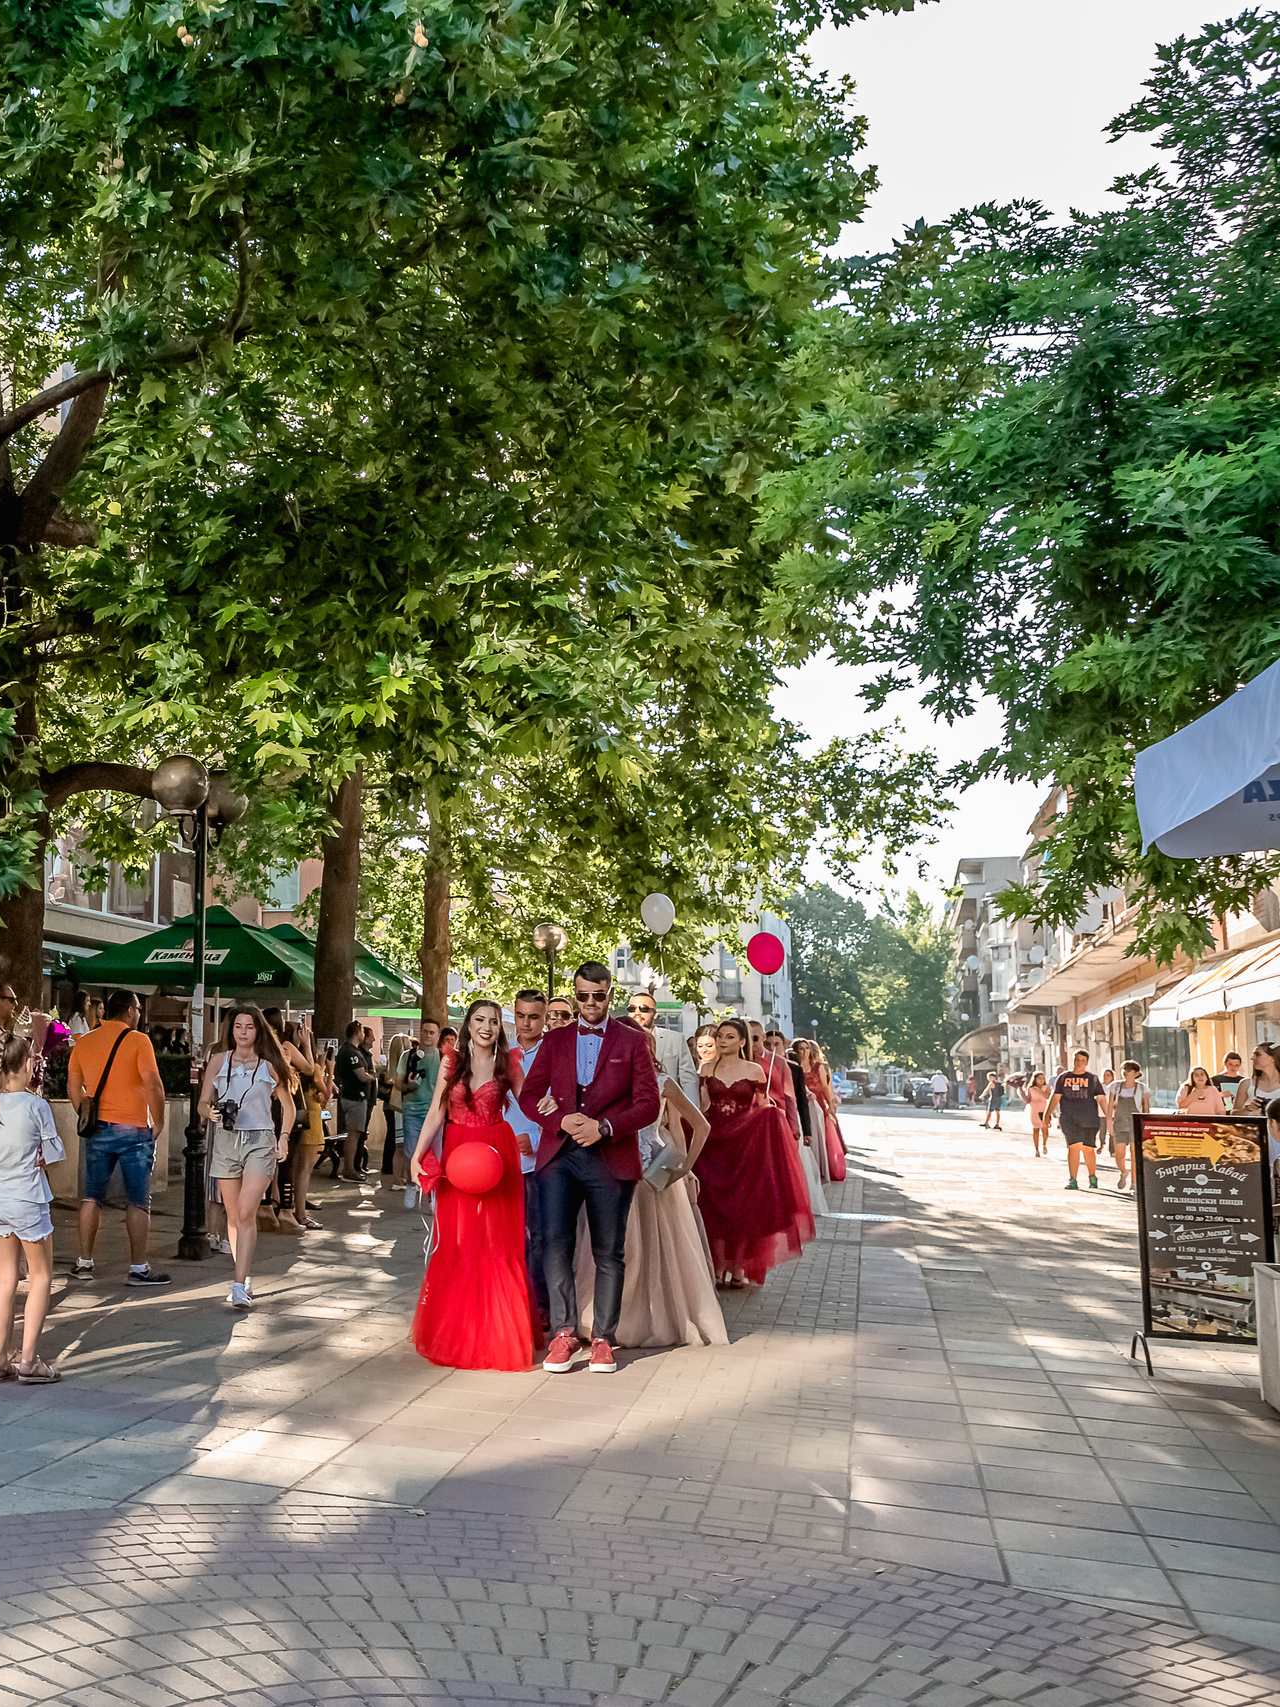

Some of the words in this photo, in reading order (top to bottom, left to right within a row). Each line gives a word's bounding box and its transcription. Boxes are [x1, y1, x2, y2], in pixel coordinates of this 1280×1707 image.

[151, 950, 222, 961] Каменца
[257, 972, 273, 981] 1881
[1063, 1077, 1089, 1088] RUN
[1155, 1163, 1206, 1179] Бирария
[1208, 1163, 1249, 1182] Хавай
